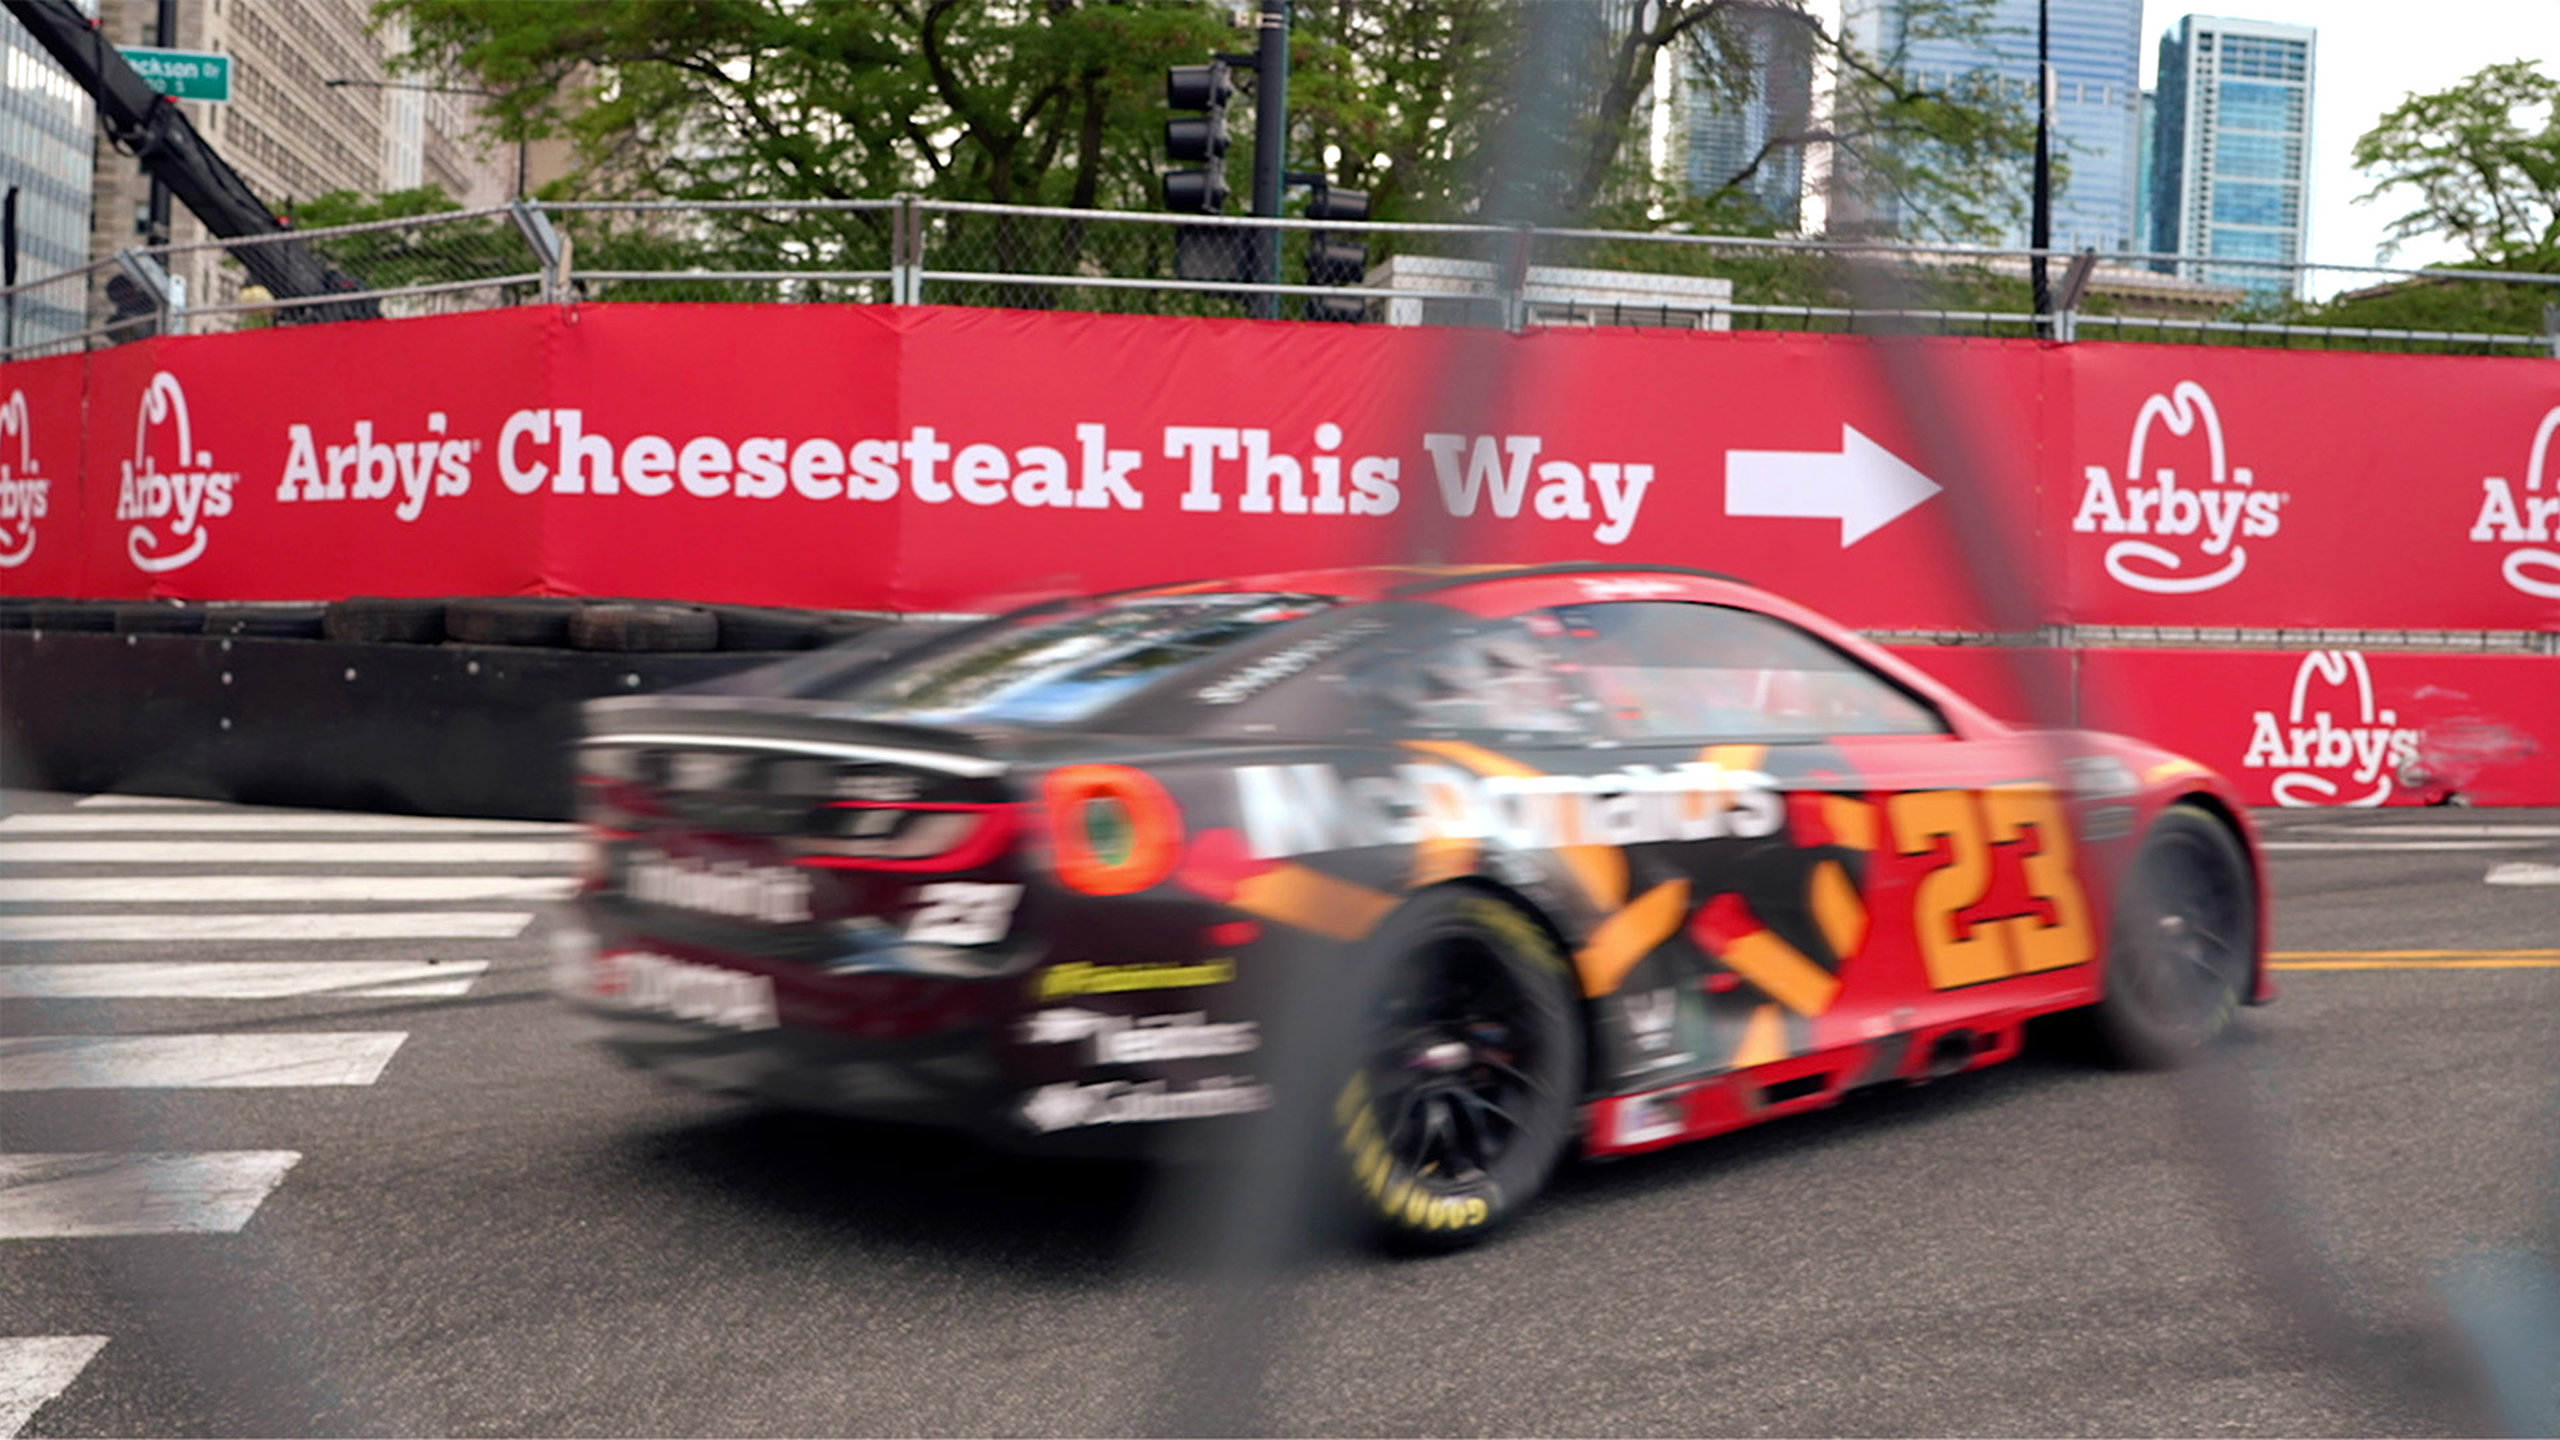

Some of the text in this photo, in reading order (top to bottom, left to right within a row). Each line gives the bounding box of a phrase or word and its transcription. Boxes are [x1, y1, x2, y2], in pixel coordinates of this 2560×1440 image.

[124, 56, 199, 79] ackson
[116, 450, 234, 536] Arby's
[276, 408, 1655, 544] Arby's Cheesesteak This Way
[2072, 466, 2282, 555] Arby's
[2243, 710, 2420, 783] Arby's
[1886, 781, 2097, 993] 23
